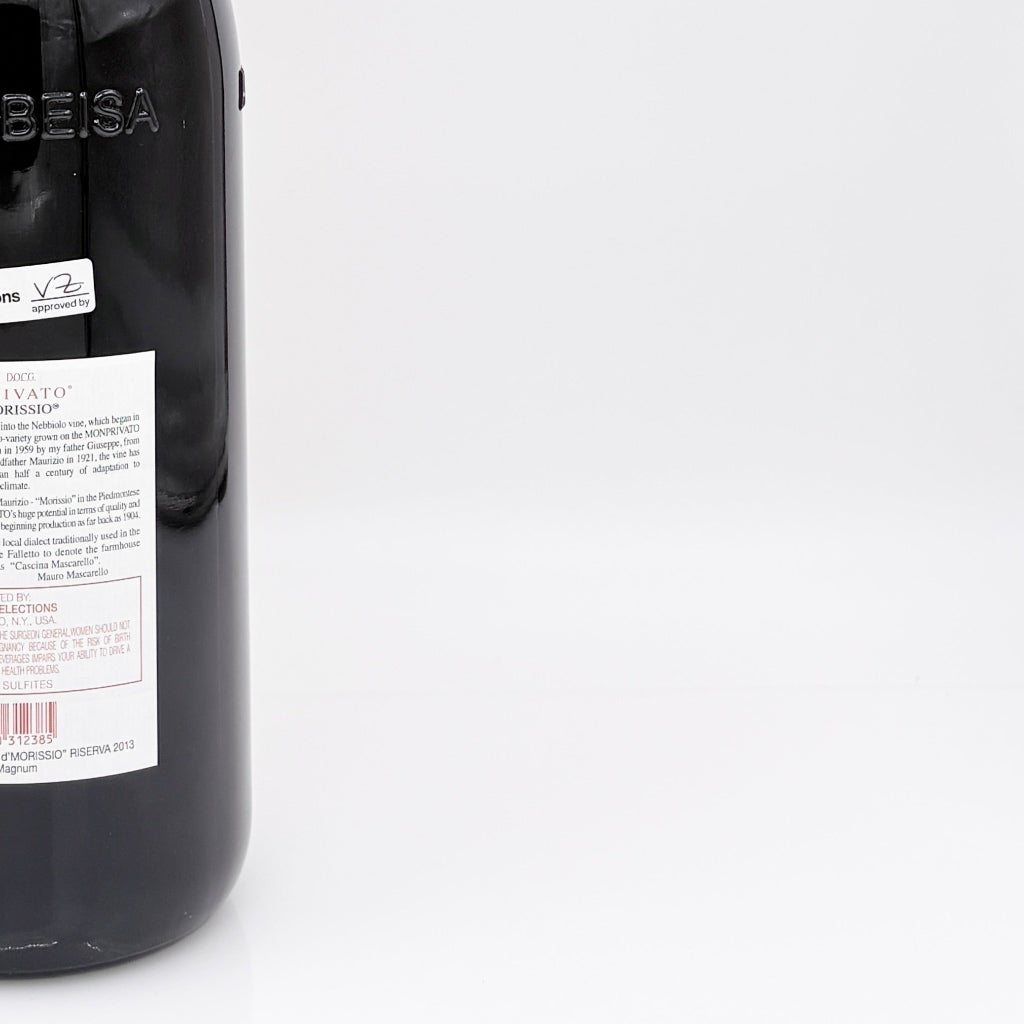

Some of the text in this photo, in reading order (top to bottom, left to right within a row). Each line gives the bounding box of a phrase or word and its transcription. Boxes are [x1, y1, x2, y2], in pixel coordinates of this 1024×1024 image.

[31, 297, 91, 314] approved by
[0, 421, 16, 430] into
[31, 420, 66, 429] Nebbiolo
[88, 416, 110, 425] which
[111, 415, 131, 425] began
[33, 434, 58, 444] grown
[85, 424, 139, 438] MONPRIVATO
[15, 445, 34, 454] 1959
[63, 443, 84, 452] father
[123, 437, 139, 445] from
[29, 457, 64, 465] Maurizio
[14, 469, 30, 478] half
[45, 469, 74, 477] century
[92, 463, 128, 474] adaptation
[17, 509, 35, 520] huge
[36, 507, 67, 519] potential
[0, 522, 36, 532] beginning
[38, 520, 76, 531] production
[2, 537, 22, 546] local
[23, 537, 50, 546] dialect
[52, 533, 98, 544] traditionally
[7, 549, 40, 558] Falletto
[54, 548, 82, 556] denote
[101, 541, 140, 551] farmhouse
[10, 561, 48, 570] “Cascina
[37, 568, 108, 581] Mauro Mascarello
[28, 640, 56, 651] BECAUSE
[1, 665, 24, 675] HEALTH
[2, 679, 52, 690] SULFITES
[8, 734, 53, 745] 312385
[69, 744, 111, 757] RISERVA
[113, 739, 134, 752] 2013
